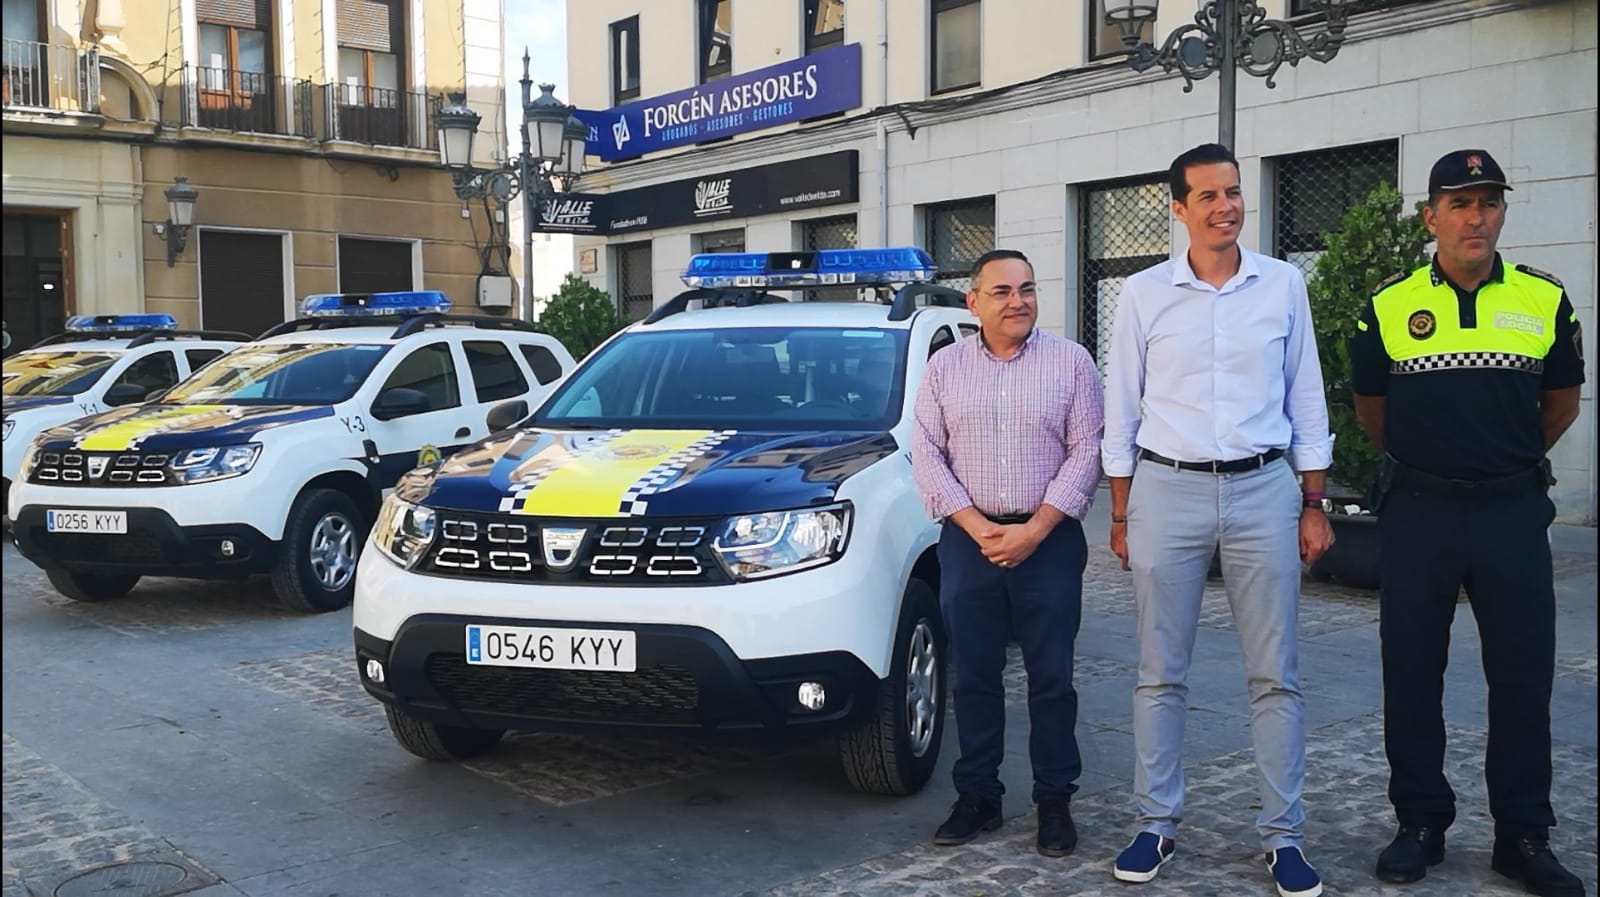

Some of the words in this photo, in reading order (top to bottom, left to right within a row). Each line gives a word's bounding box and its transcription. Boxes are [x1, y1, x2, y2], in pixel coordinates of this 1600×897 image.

[643, 90, 714, 137] FORCÉN
[719, 65, 818, 115] ASESORES
[706, 113, 743, 131] ASESORES
[753, 102, 794, 121] GESTORES
[550, 199, 594, 223] VALLE
[80, 403, 98, 415] Y-1
[340, 415, 365, 433] Y-3
[57, 513, 88, 529] 0256
[95, 514, 121, 530] KYY
[487, 632, 554, 662] 0546
[571, 636, 623, 666] KYY
